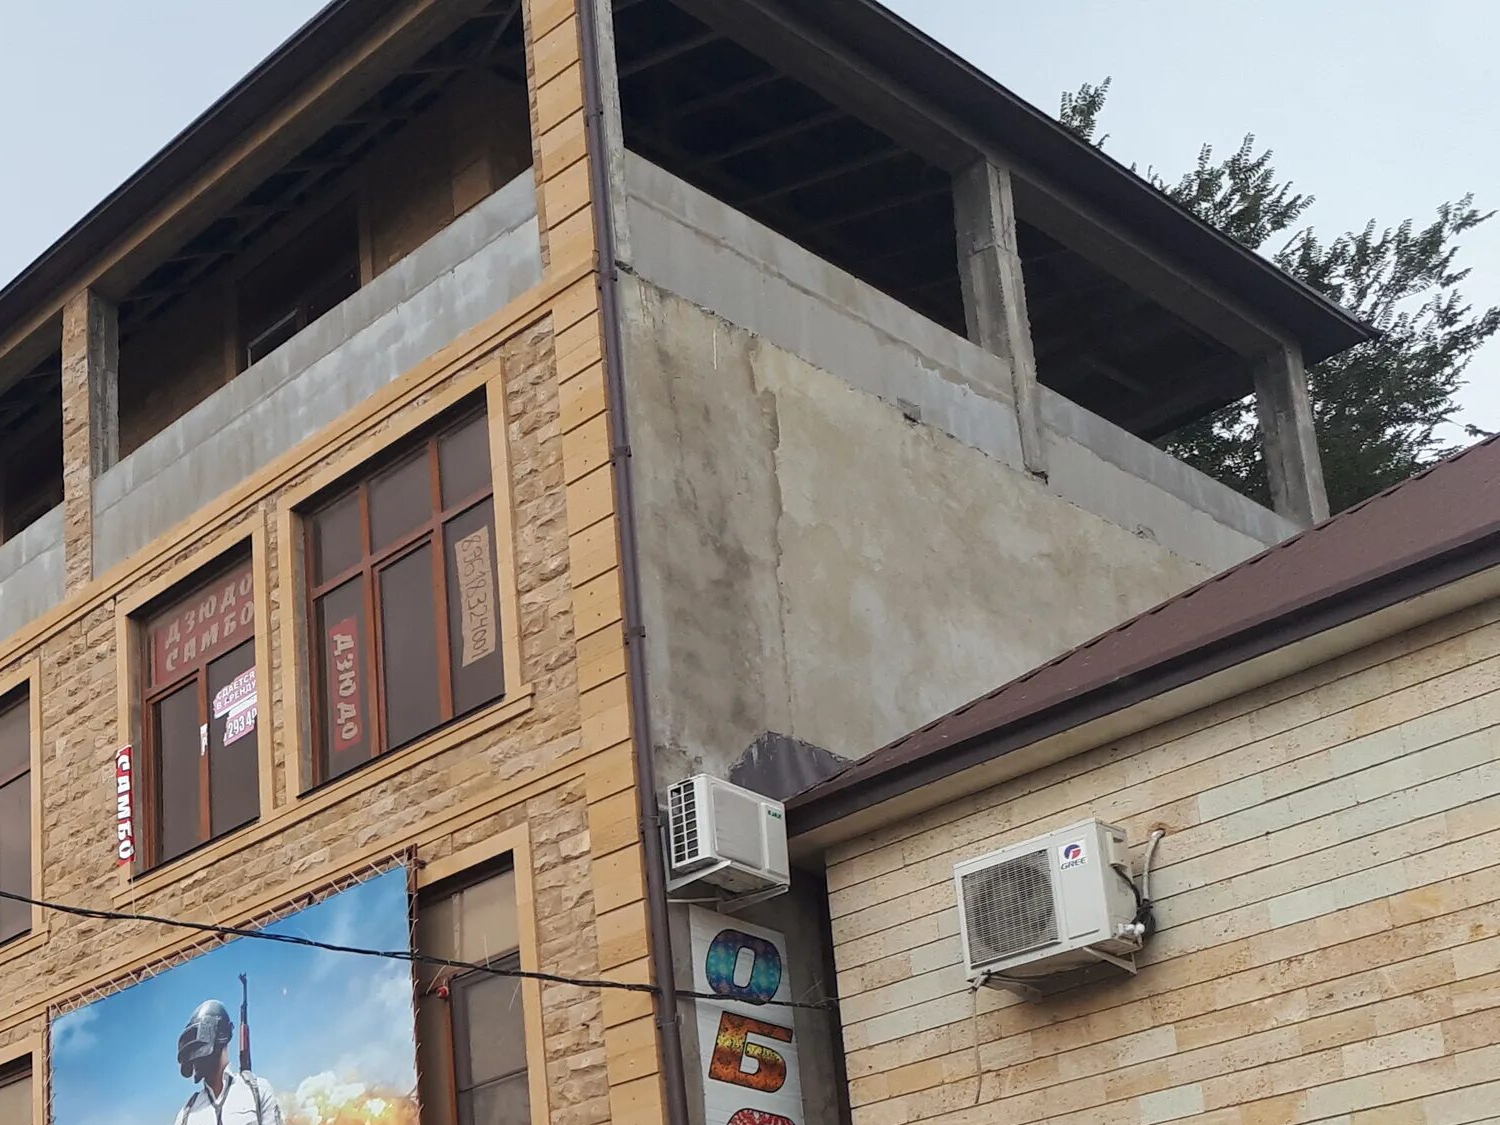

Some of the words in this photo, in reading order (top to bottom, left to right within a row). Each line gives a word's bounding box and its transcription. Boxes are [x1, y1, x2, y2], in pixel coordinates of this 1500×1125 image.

[165, 572, 252, 650] ДЗЮДО
[165, 600, 254, 672] САМБО
[331, 632, 359, 742] ДЗЮДО
[117, 748, 134, 861] САМБО
[1061, 856, 1087, 870] GREE
